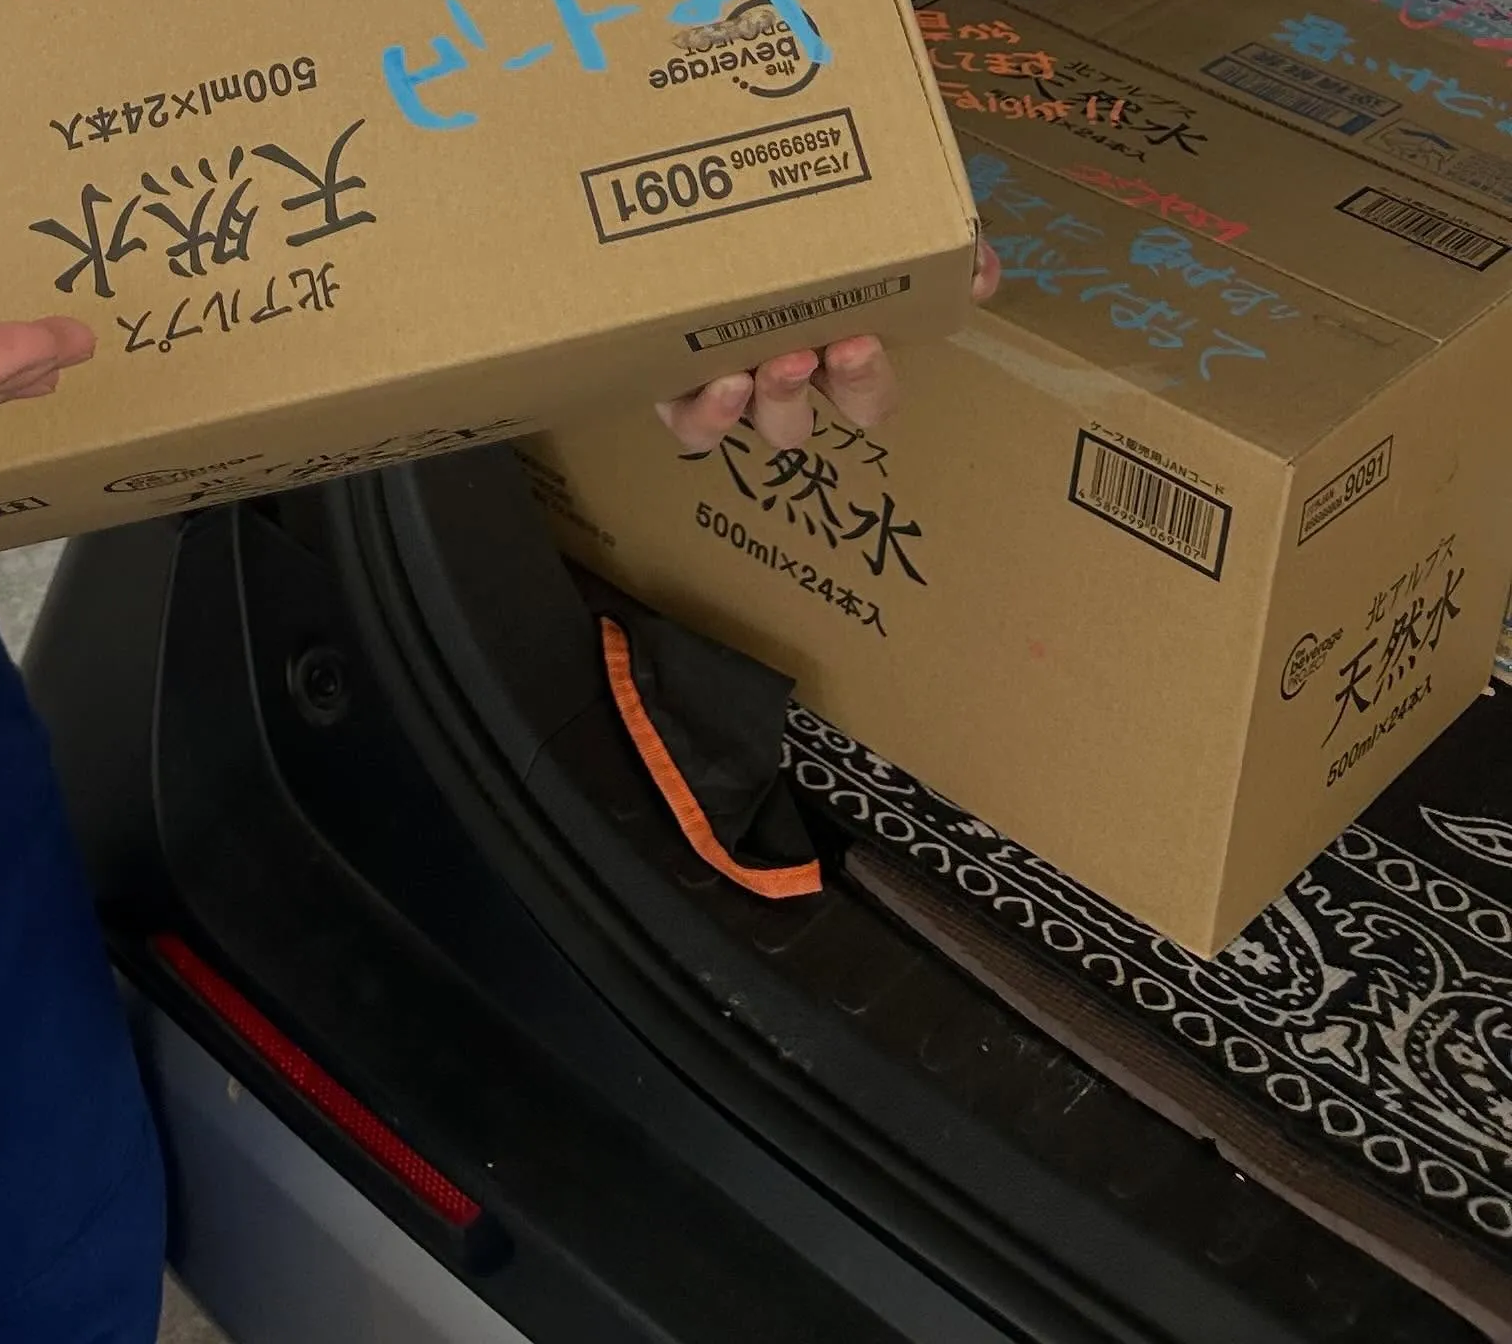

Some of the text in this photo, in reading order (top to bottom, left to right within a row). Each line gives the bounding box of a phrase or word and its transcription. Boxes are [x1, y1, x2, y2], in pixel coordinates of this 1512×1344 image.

[643, 27, 801, 97] beverage
[763, 56, 797, 80] the
[727, 124, 843, 172] 458999906
[19, 113, 391, 314] 天然水
[607, 150, 736, 224] 9091
[112, 259, 345, 363] 北アルプス
[1344, 451, 1385, 503] 9091
[1322, 567, 1465, 750] 天然水
